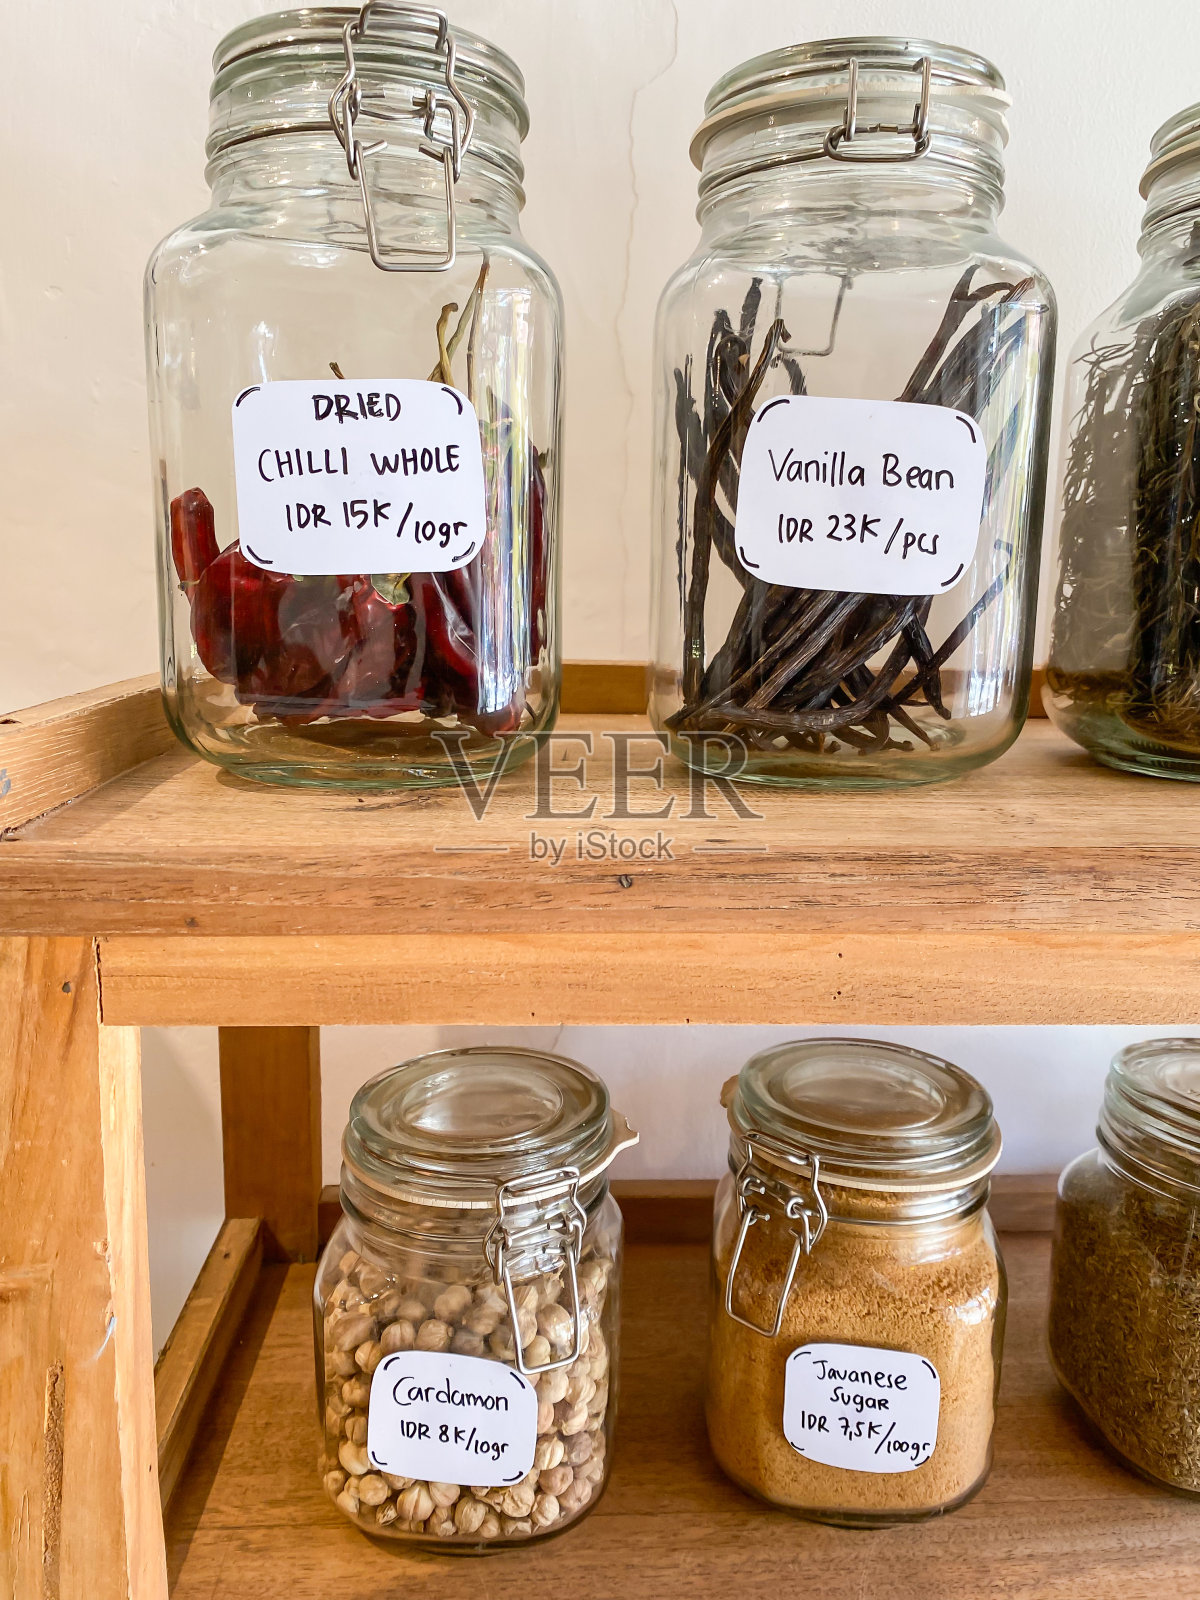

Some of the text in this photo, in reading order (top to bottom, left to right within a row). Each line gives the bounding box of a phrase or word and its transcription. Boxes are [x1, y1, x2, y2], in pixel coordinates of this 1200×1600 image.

[312, 393, 401, 424] DRIED
[259, 445, 459, 482] CHILLI WHOLE
[768, 448, 954, 490] Vanilla Bean
[286, 503, 331, 532] IDR
[779, 514, 813, 543] IDR
[812, 1359, 908, 1391] Javanese
[392, 1376, 509, 1411] Cardamon
[401, 1420, 430, 1440] IDR
[802, 1411, 829, 1432] IDR
